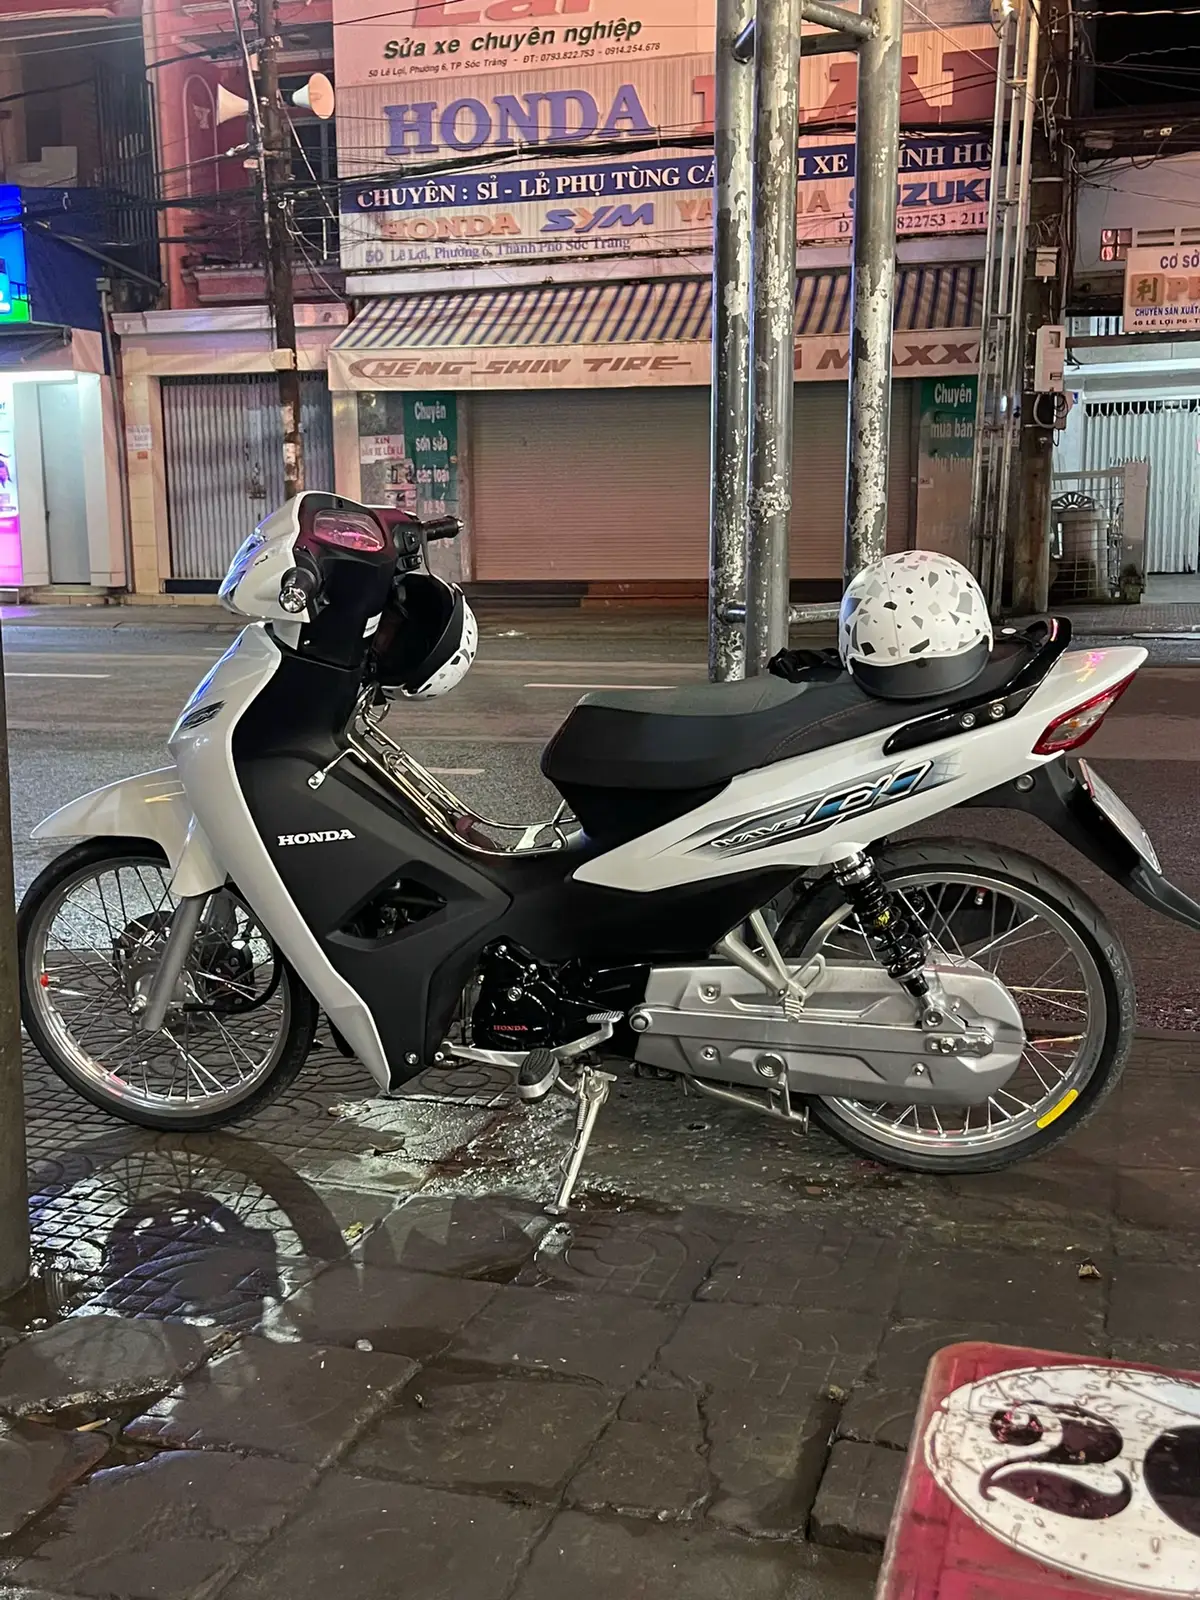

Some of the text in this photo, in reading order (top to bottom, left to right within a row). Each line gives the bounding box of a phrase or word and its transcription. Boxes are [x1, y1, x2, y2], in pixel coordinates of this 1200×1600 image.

[383, 17, 642, 60] Sửa xe chuyên nghiệp
[368, 69, 378, 78] 50
[450, 61, 462, 71] TP
[464, 59, 480, 69] Sóc
[540, 49, 595, 62] 0793.822.753
[605, 42, 661, 56] 0914.254.678
[383, 84, 656, 155] HONDA
[357, 180, 457, 208] CHUYÊN
[477, 175, 499, 201] SỈ
[520, 171, 551, 197] LẺ
[556, 173, 605, 196] PHỤ
[611, 165, 681, 190] TÙNG
[813, 153, 849, 175] XE
[380, 212, 521, 241] HONDA
[540, 203, 655, 234] SYM
[365, 249, 384, 263] 50
[1160, 253, 1178, 269] CƠ
[348, 355, 692, 378] CHENG SHIN TIRE
[934, 383, 972, 408] Chuyên
[414, 401, 447, 423] Chuyên
[931, 421, 951, 438] mua
[954, 417, 972, 437] bán
[277, 829, 356, 847] HONDA
